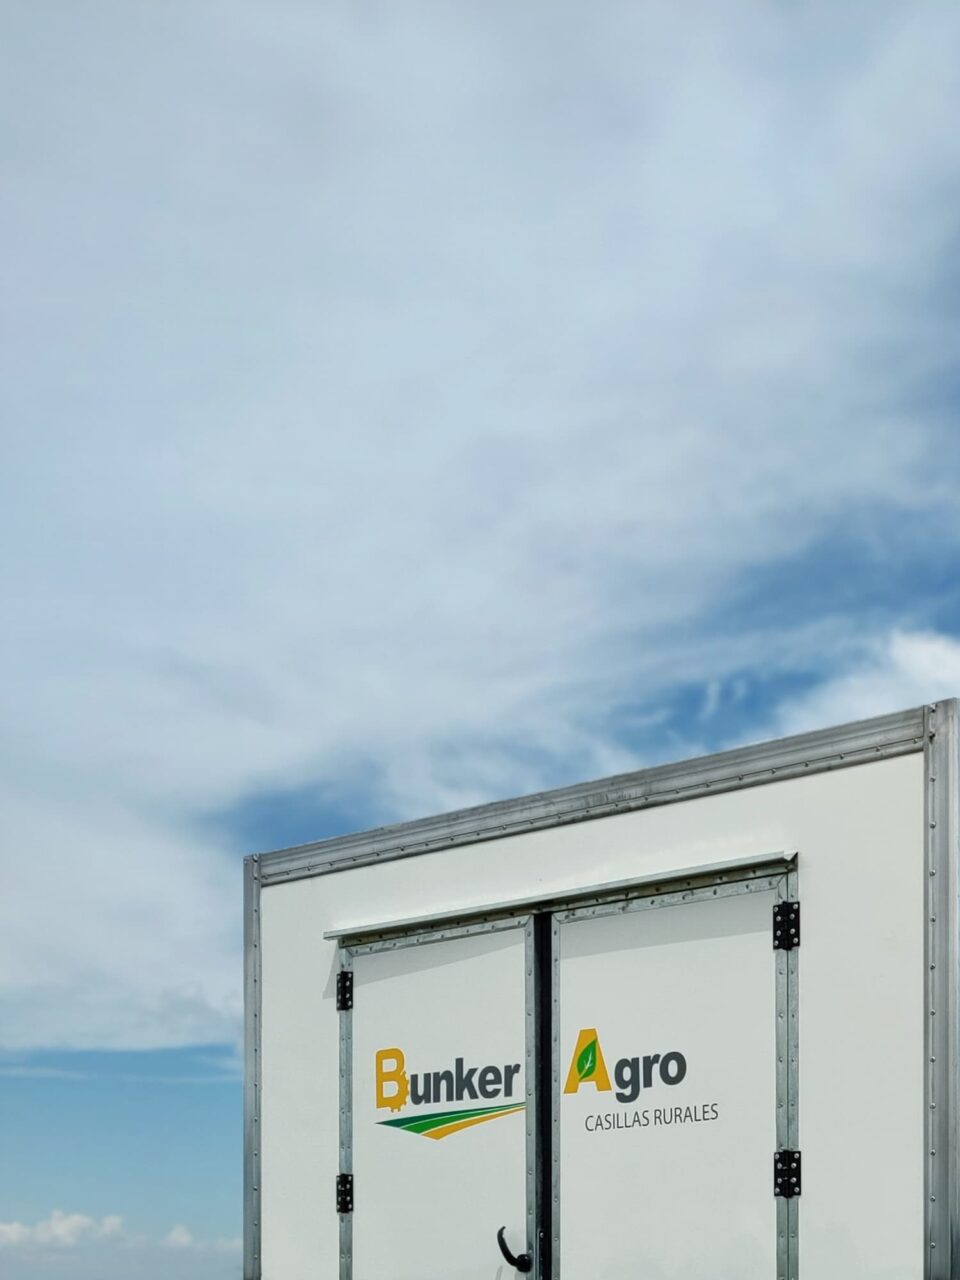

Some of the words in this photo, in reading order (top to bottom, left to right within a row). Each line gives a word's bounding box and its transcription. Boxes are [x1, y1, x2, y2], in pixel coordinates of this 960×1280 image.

[375, 1047, 521, 1113] Bunker
[563, 1028, 687, 1104] Agro
[585, 1110, 650, 1132] CASILLAS
[654, 1103, 719, 1126] RURALES
